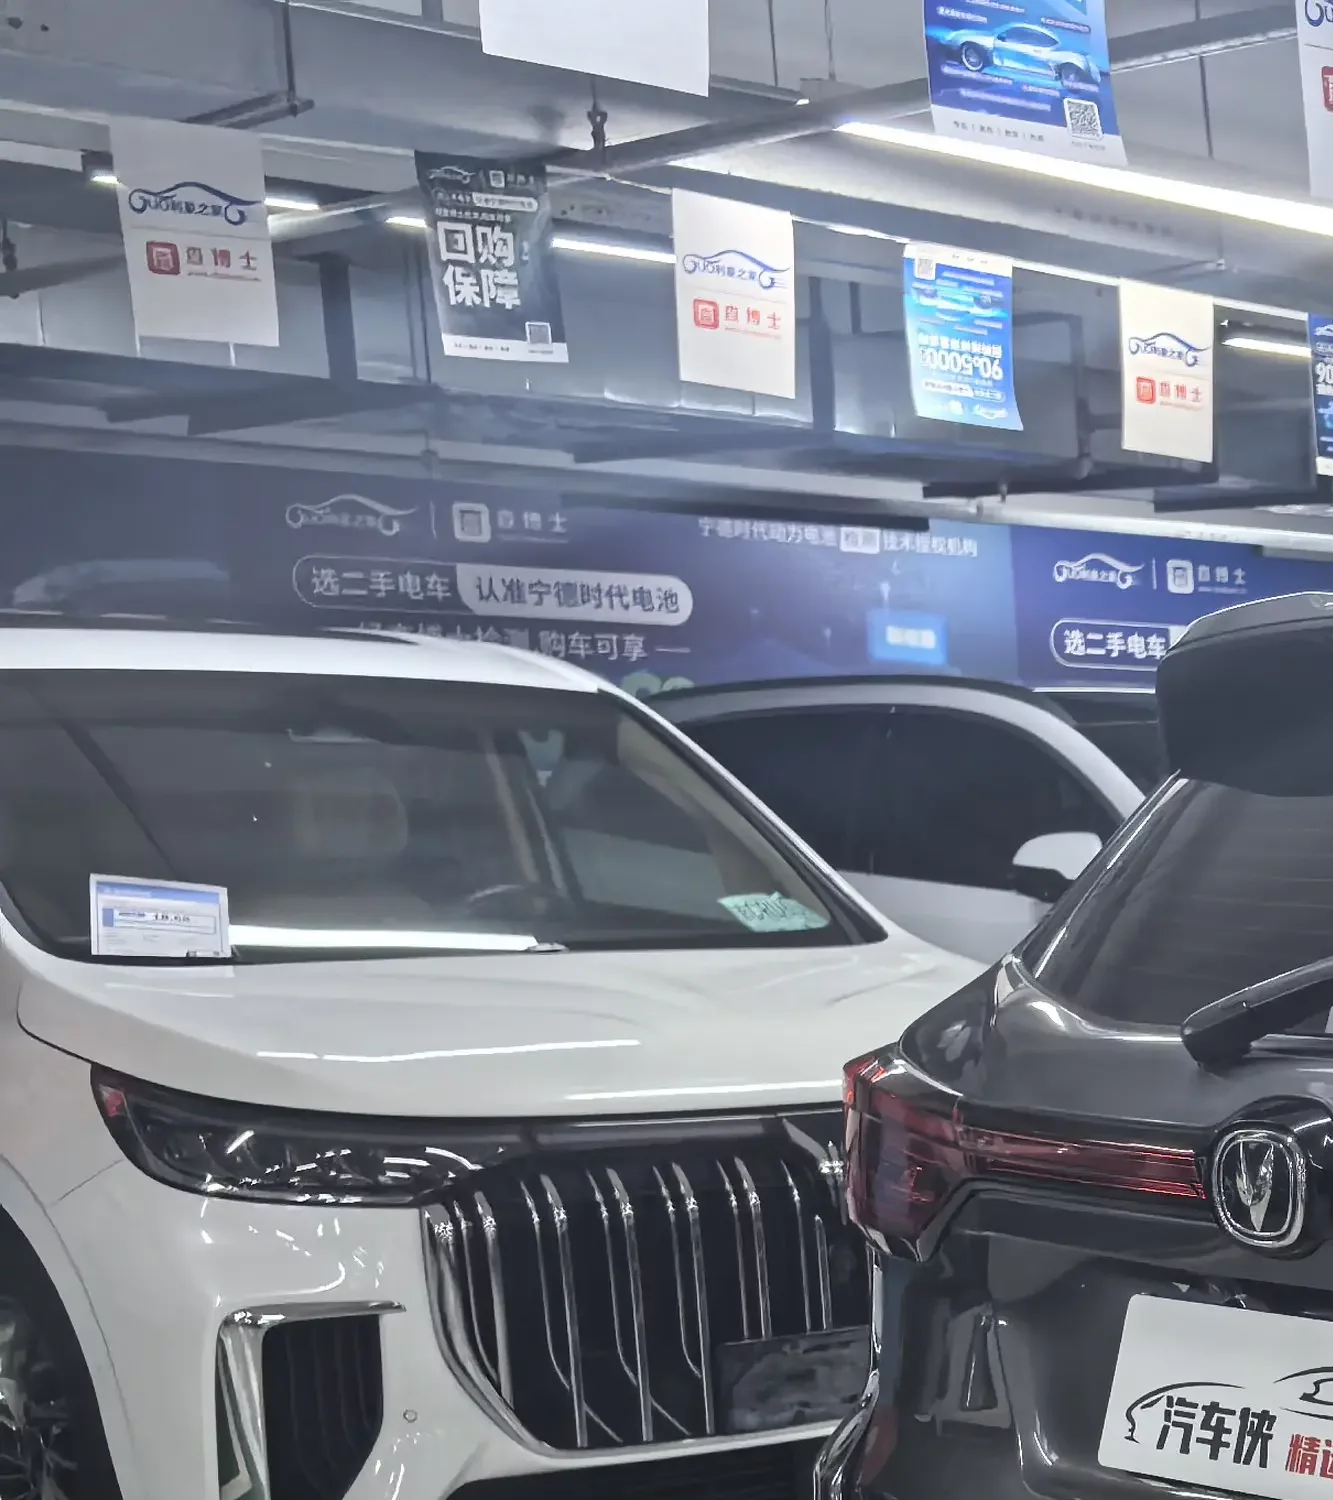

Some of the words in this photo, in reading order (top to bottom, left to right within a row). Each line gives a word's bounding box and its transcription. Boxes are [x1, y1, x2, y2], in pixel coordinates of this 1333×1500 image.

[437, 221, 515, 267] 回购
[443, 264, 521, 310] 保障
[310, 565, 452, 602] 选二手电车
[1063, 628, 1168, 661] 选二手电车
[1155, 1394, 1278, 1469] 汽车侠
